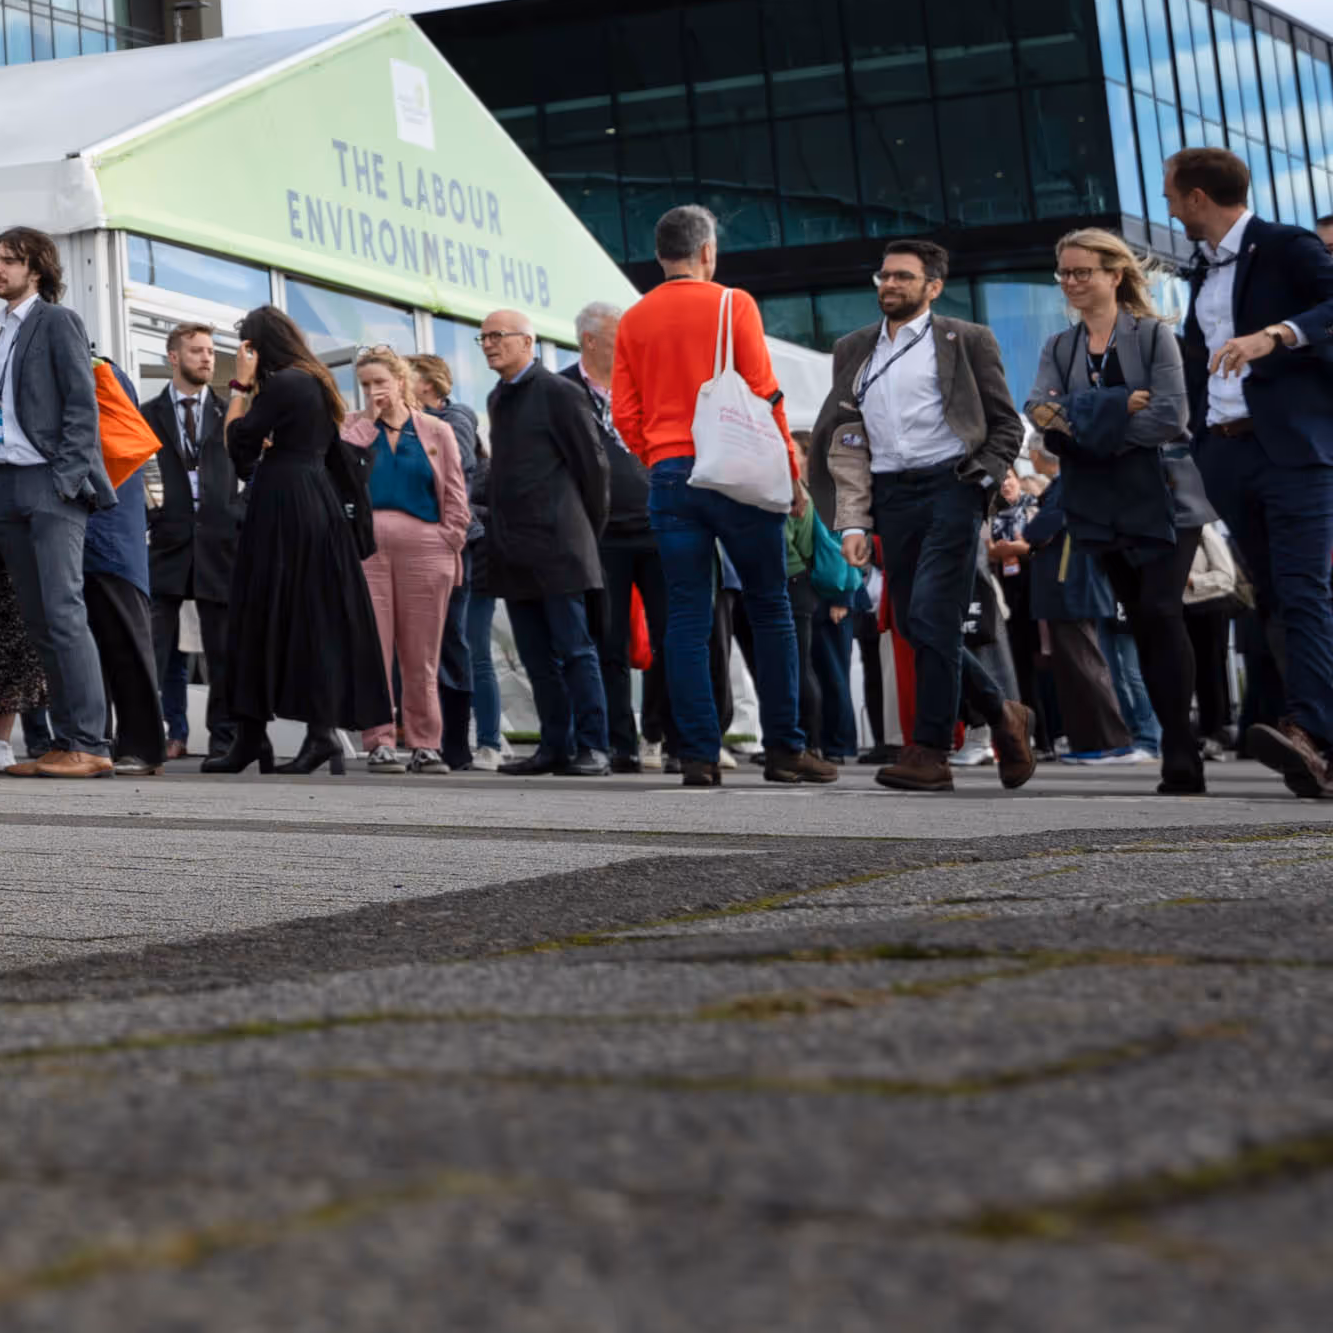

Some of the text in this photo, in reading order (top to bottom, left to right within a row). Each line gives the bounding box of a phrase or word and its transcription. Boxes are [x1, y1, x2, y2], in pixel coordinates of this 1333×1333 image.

[332, 138, 502, 236] THE LABOUR
[286, 189, 552, 309] ENVIRONMENT HUB
